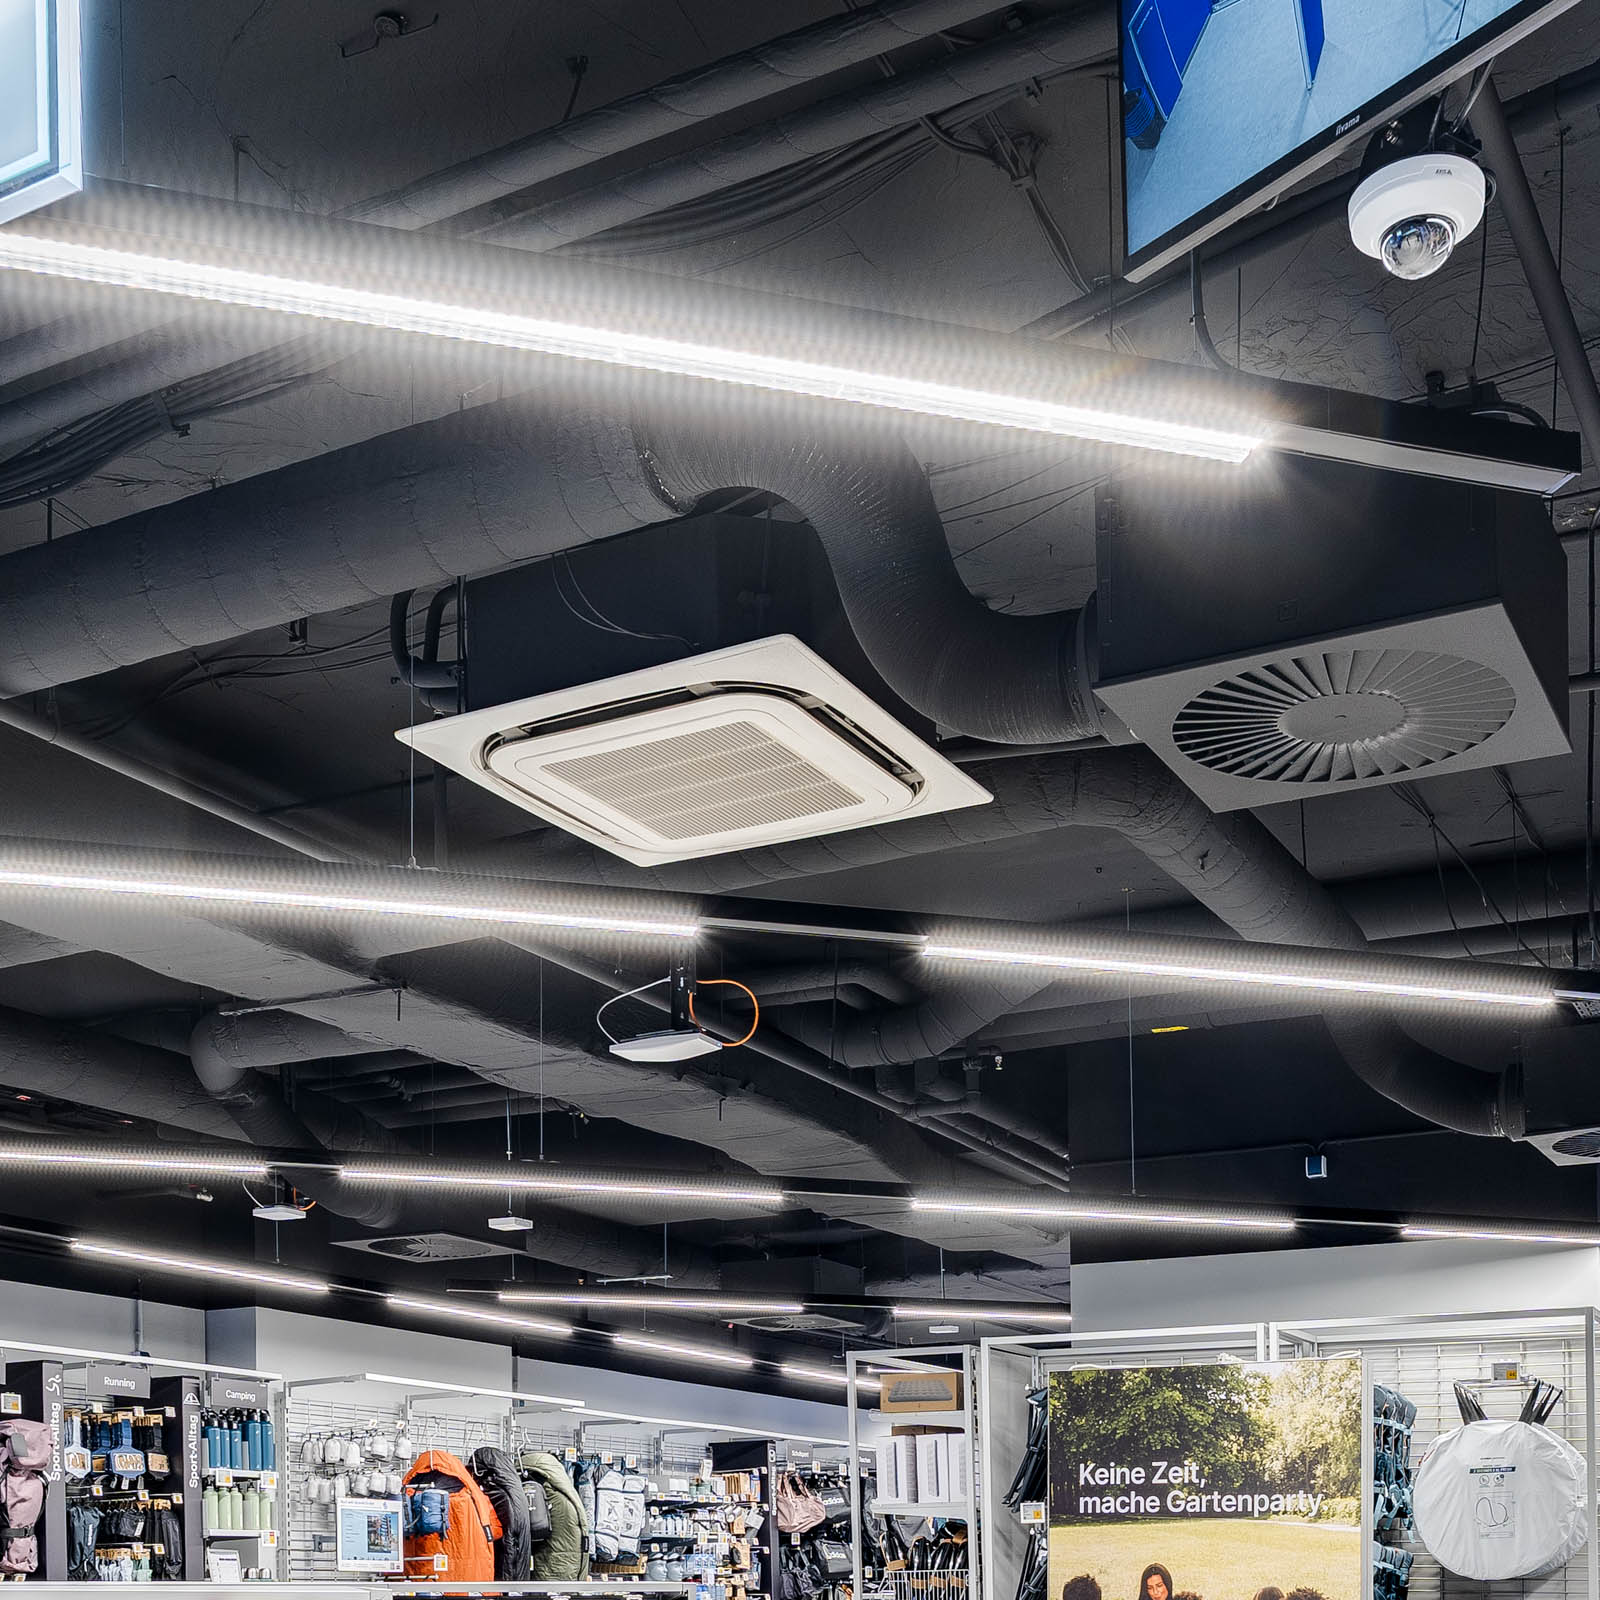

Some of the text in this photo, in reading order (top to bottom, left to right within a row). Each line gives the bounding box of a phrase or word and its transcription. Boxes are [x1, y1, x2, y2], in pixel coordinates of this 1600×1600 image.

[1335, 114, 1360, 136] iiyama
[104, 1376, 135, 1390] Running
[225, 1389, 255, 1402] Camping
[188, 1415, 200, 1488] Sport-Alltag
[1078, 1461, 1207, 1488] Keine Zeit,
[1079, 1489, 1329, 1518] mache Gartenparty.
